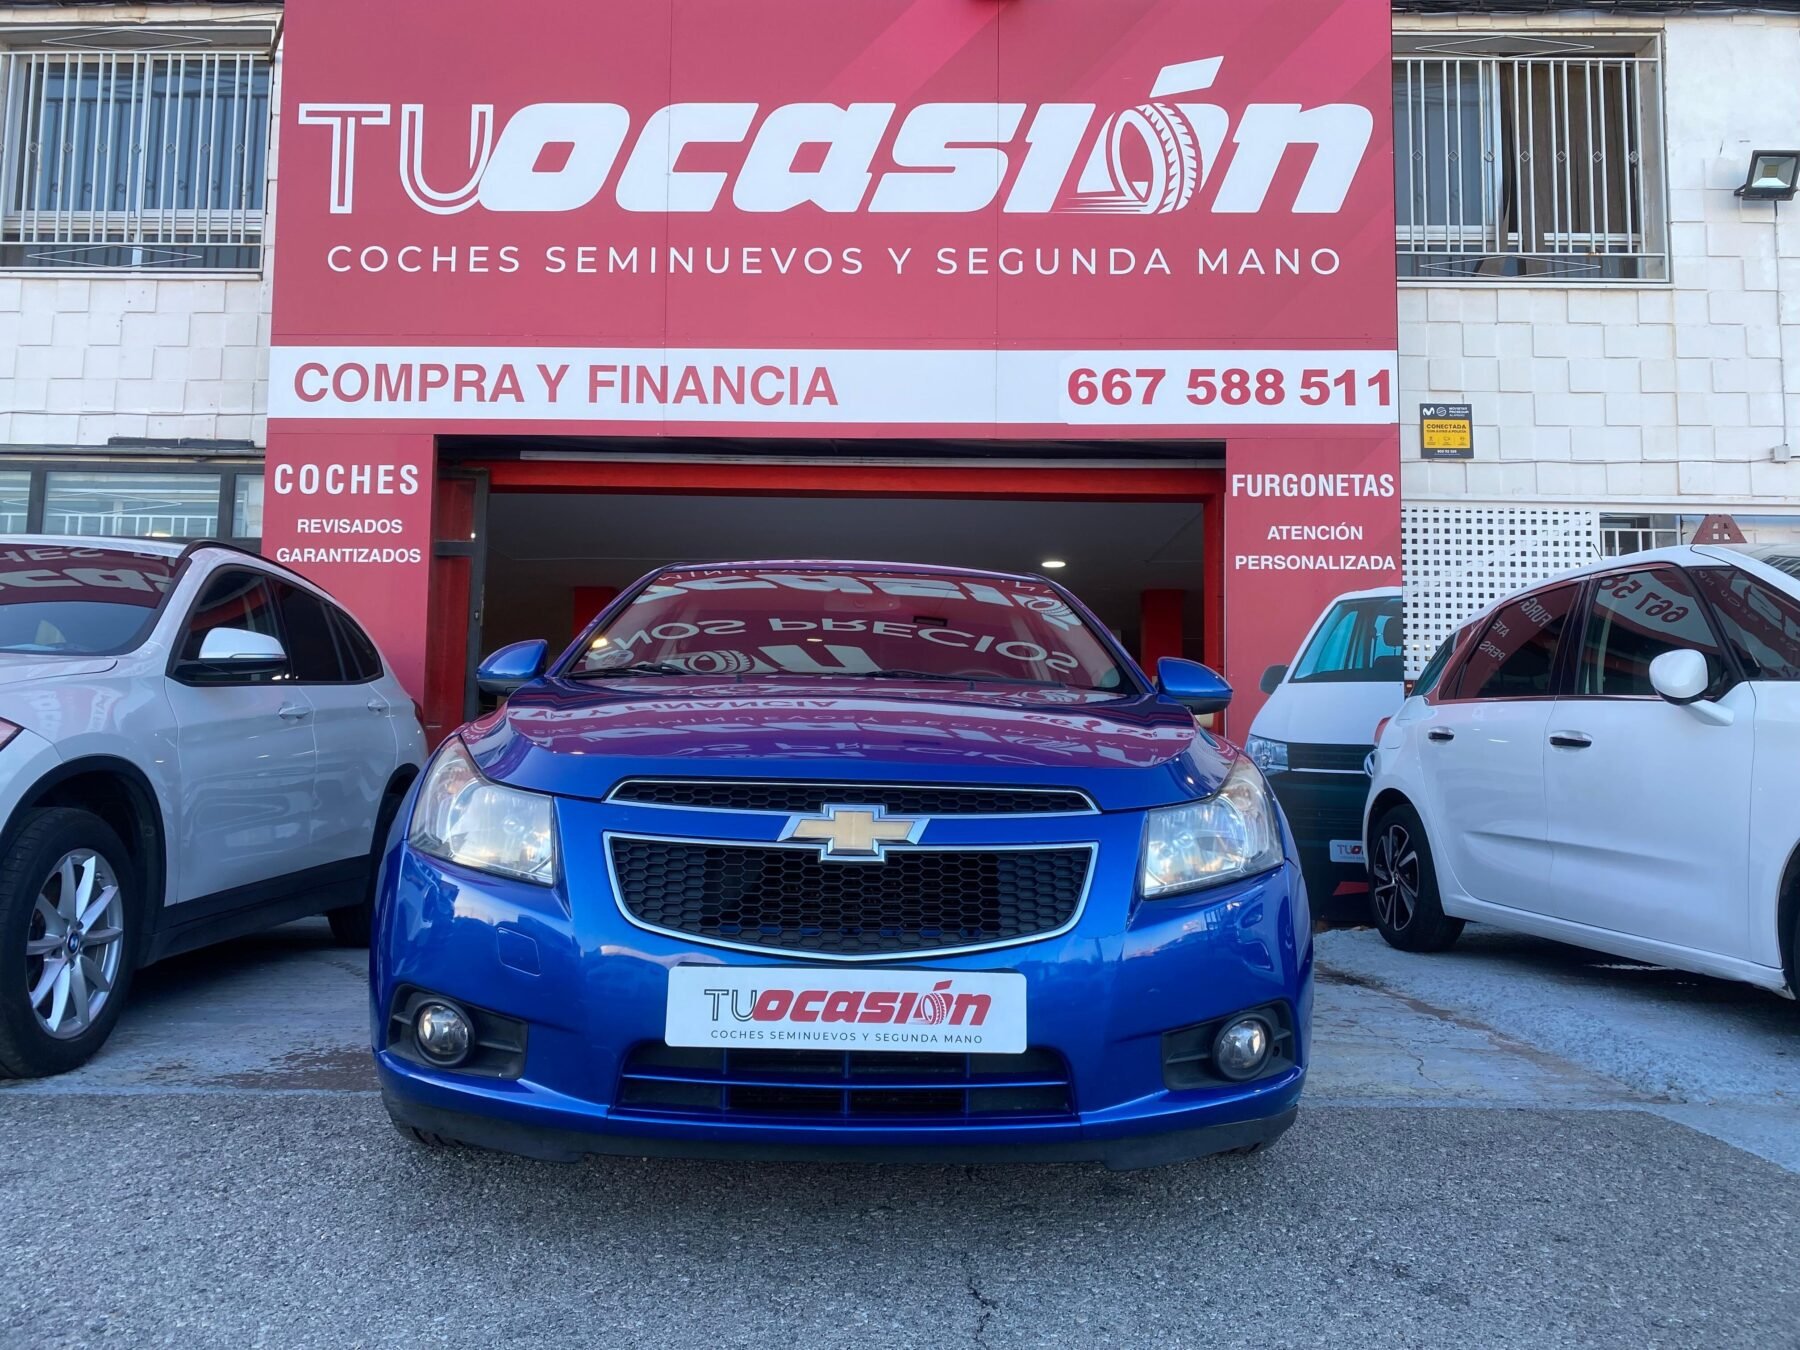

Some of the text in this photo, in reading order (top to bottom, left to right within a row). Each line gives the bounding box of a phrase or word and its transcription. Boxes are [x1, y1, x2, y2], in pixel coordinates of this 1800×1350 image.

[327, 245, 1341, 276] COCHES SEMINUEVOS Y SEGUNDA MANO
[293, 362, 838, 406] COMPRA Y FINANCIA
[1067, 368, 1390, 406] 667 588 511
[274, 463, 419, 495] COCHES
[1232, 473, 1395, 497] FURGONETAS
[297, 518, 403, 534] REVISADOS
[1267, 522, 1363, 540] ATENCIÓN
[276, 547, 421, 564] GARANTIZADOS
[1235, 555, 1396, 570] PERSONALIZADA
[711, 1029, 983, 1044] COCHES SEMINUEVOS Y SEGUNDA MANO
